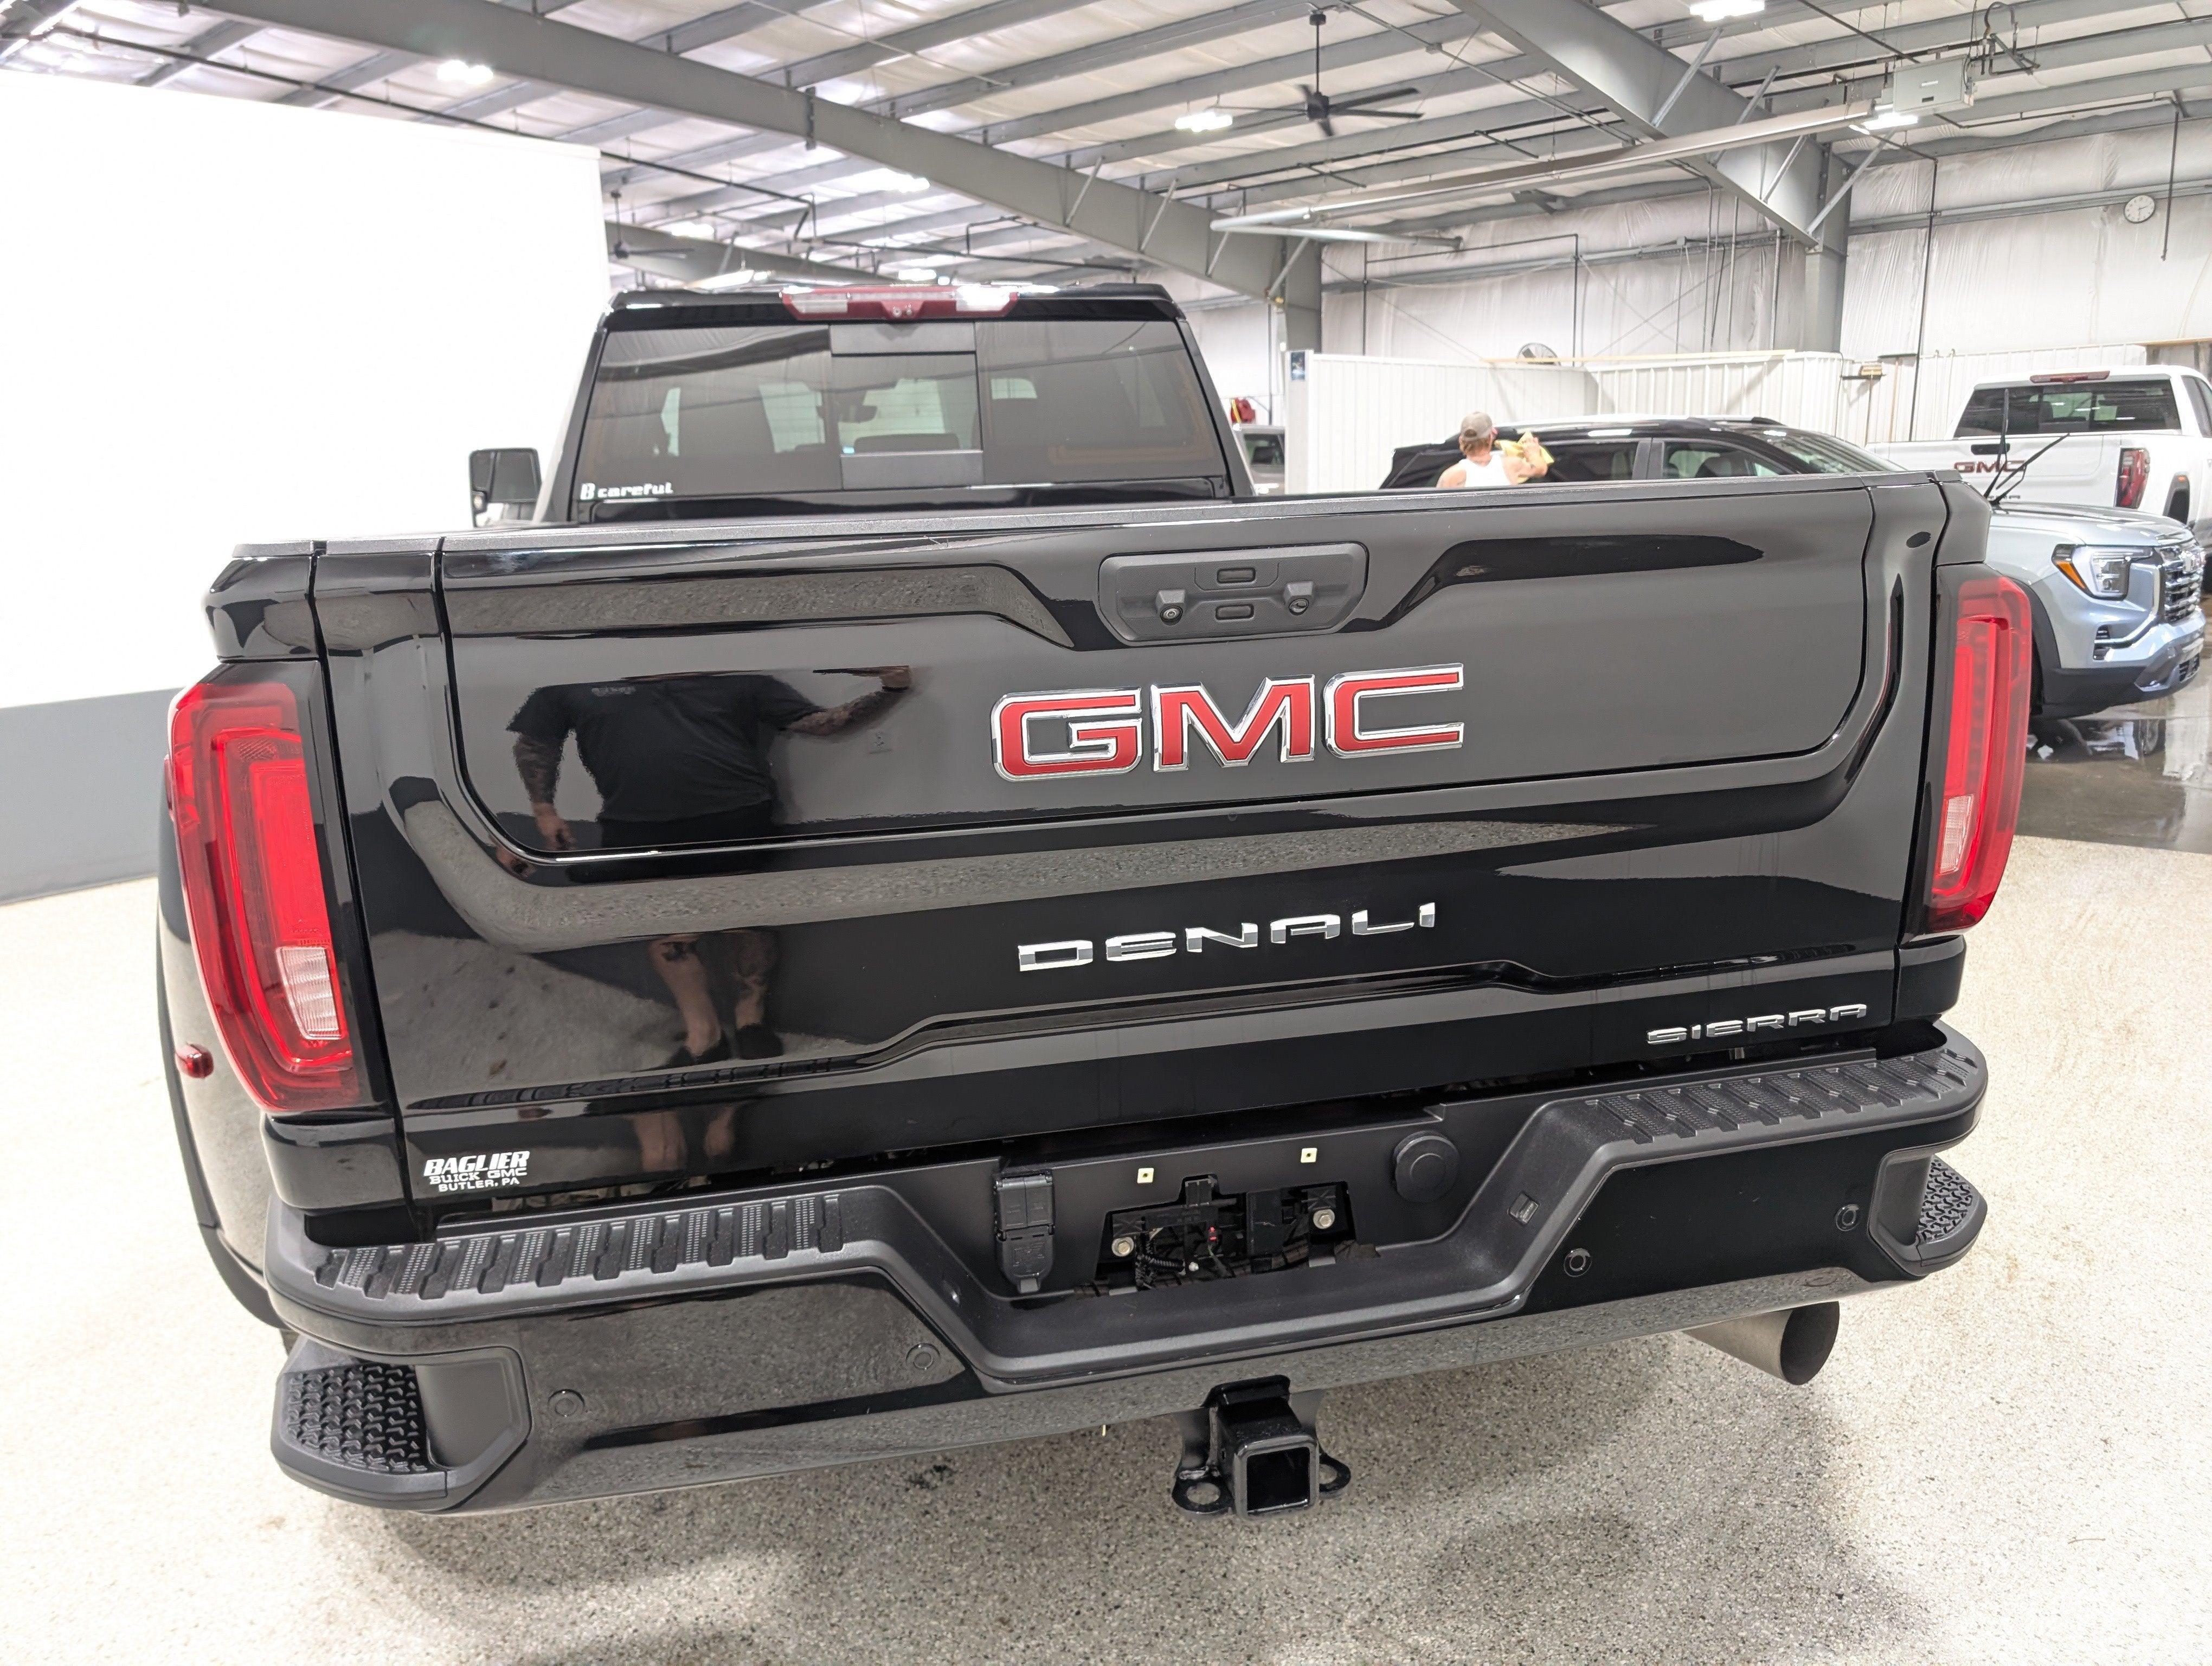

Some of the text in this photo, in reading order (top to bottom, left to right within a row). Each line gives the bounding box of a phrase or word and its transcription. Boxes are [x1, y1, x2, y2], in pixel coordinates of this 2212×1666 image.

[1954, 460, 2025, 473] GMC
[580, 483, 595, 500] B
[991, 663, 1464, 783] GMC
[1018, 902, 1436, 972] DENALI
[1647, 1003, 1867, 1045] SIERRA
[423, 1150, 531, 1177] BAGLIER
[429, 1167, 528, 1185] BUICK GMC
[501, 1177, 520, 1186] PA
